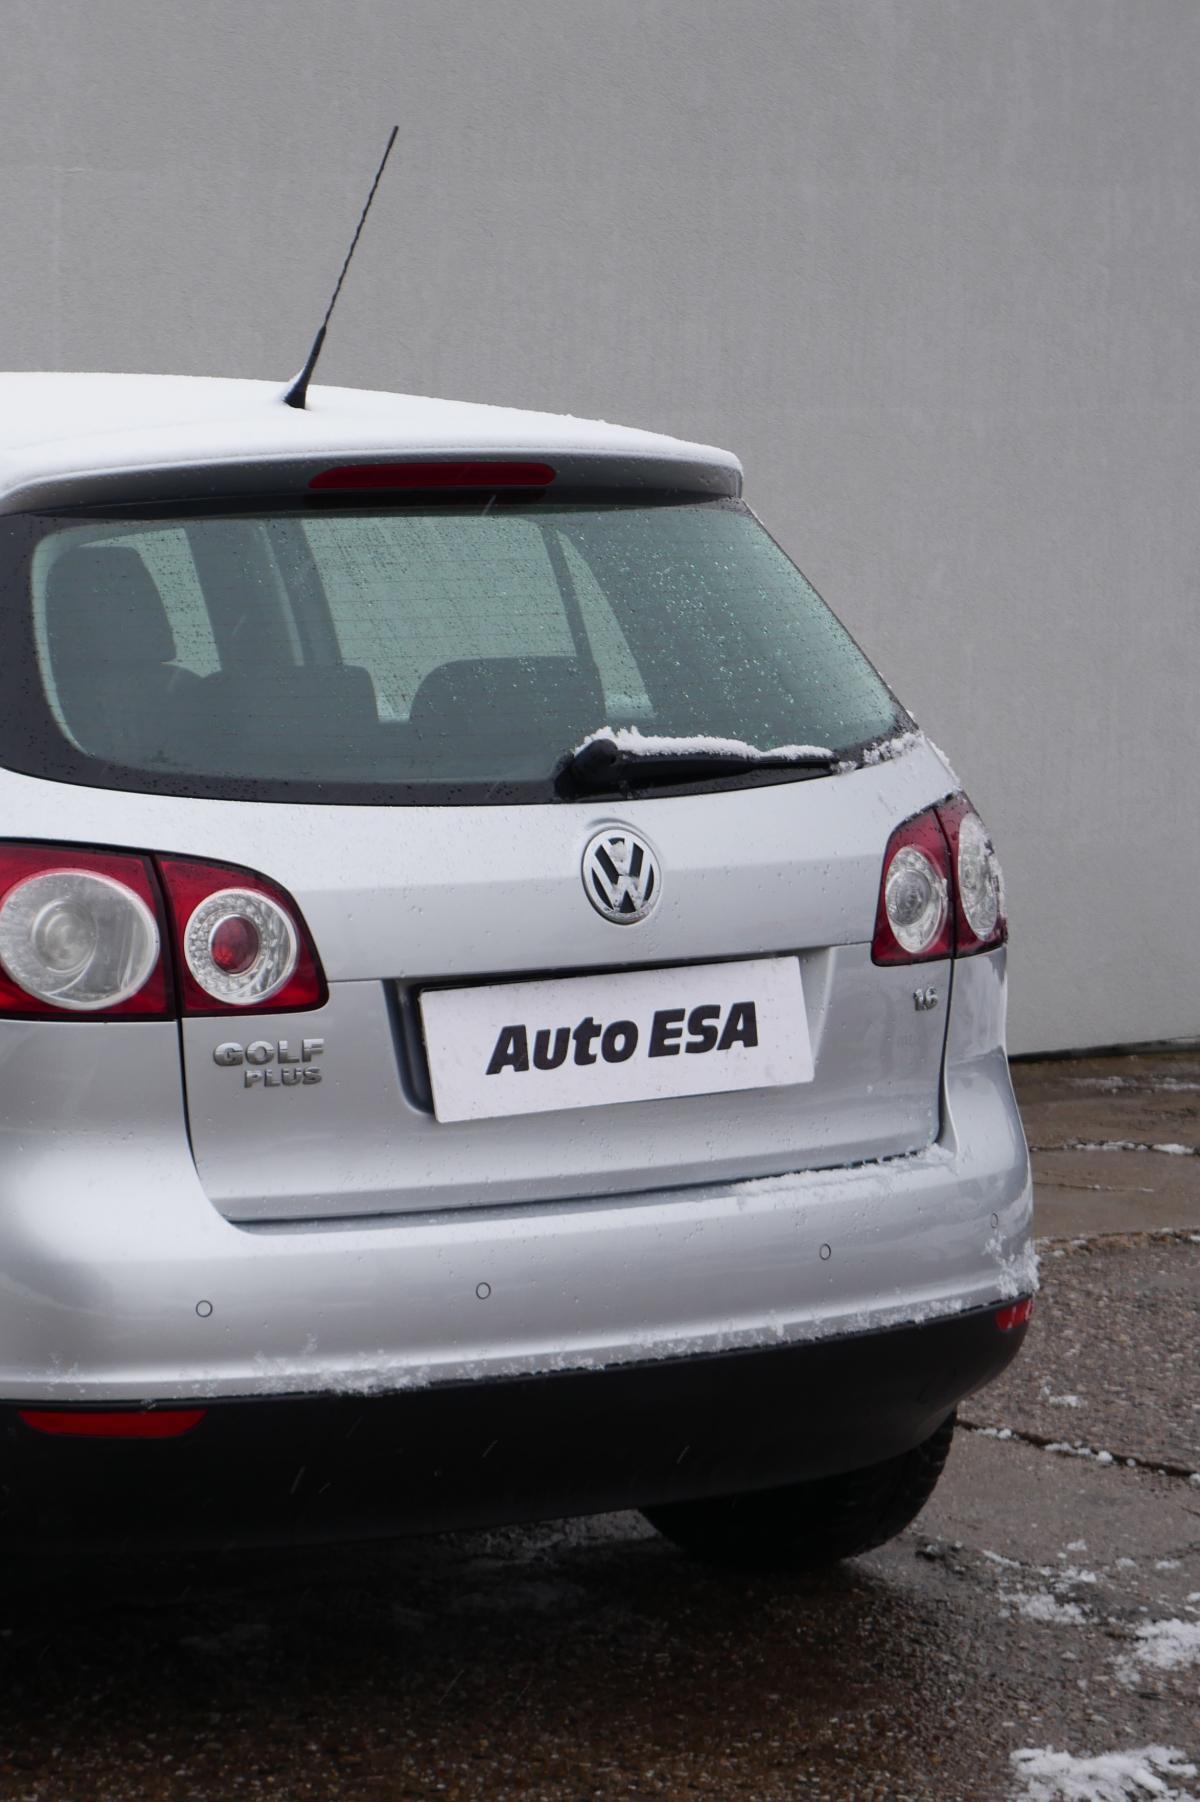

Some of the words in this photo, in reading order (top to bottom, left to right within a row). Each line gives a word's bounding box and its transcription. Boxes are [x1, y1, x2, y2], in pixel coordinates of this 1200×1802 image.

[213, 1038, 325, 1067] GOLF
[486, 1016, 639, 1075] Auto
[648, 1001, 758, 1058] ESA
[244, 1066, 322, 1088] PLUS
